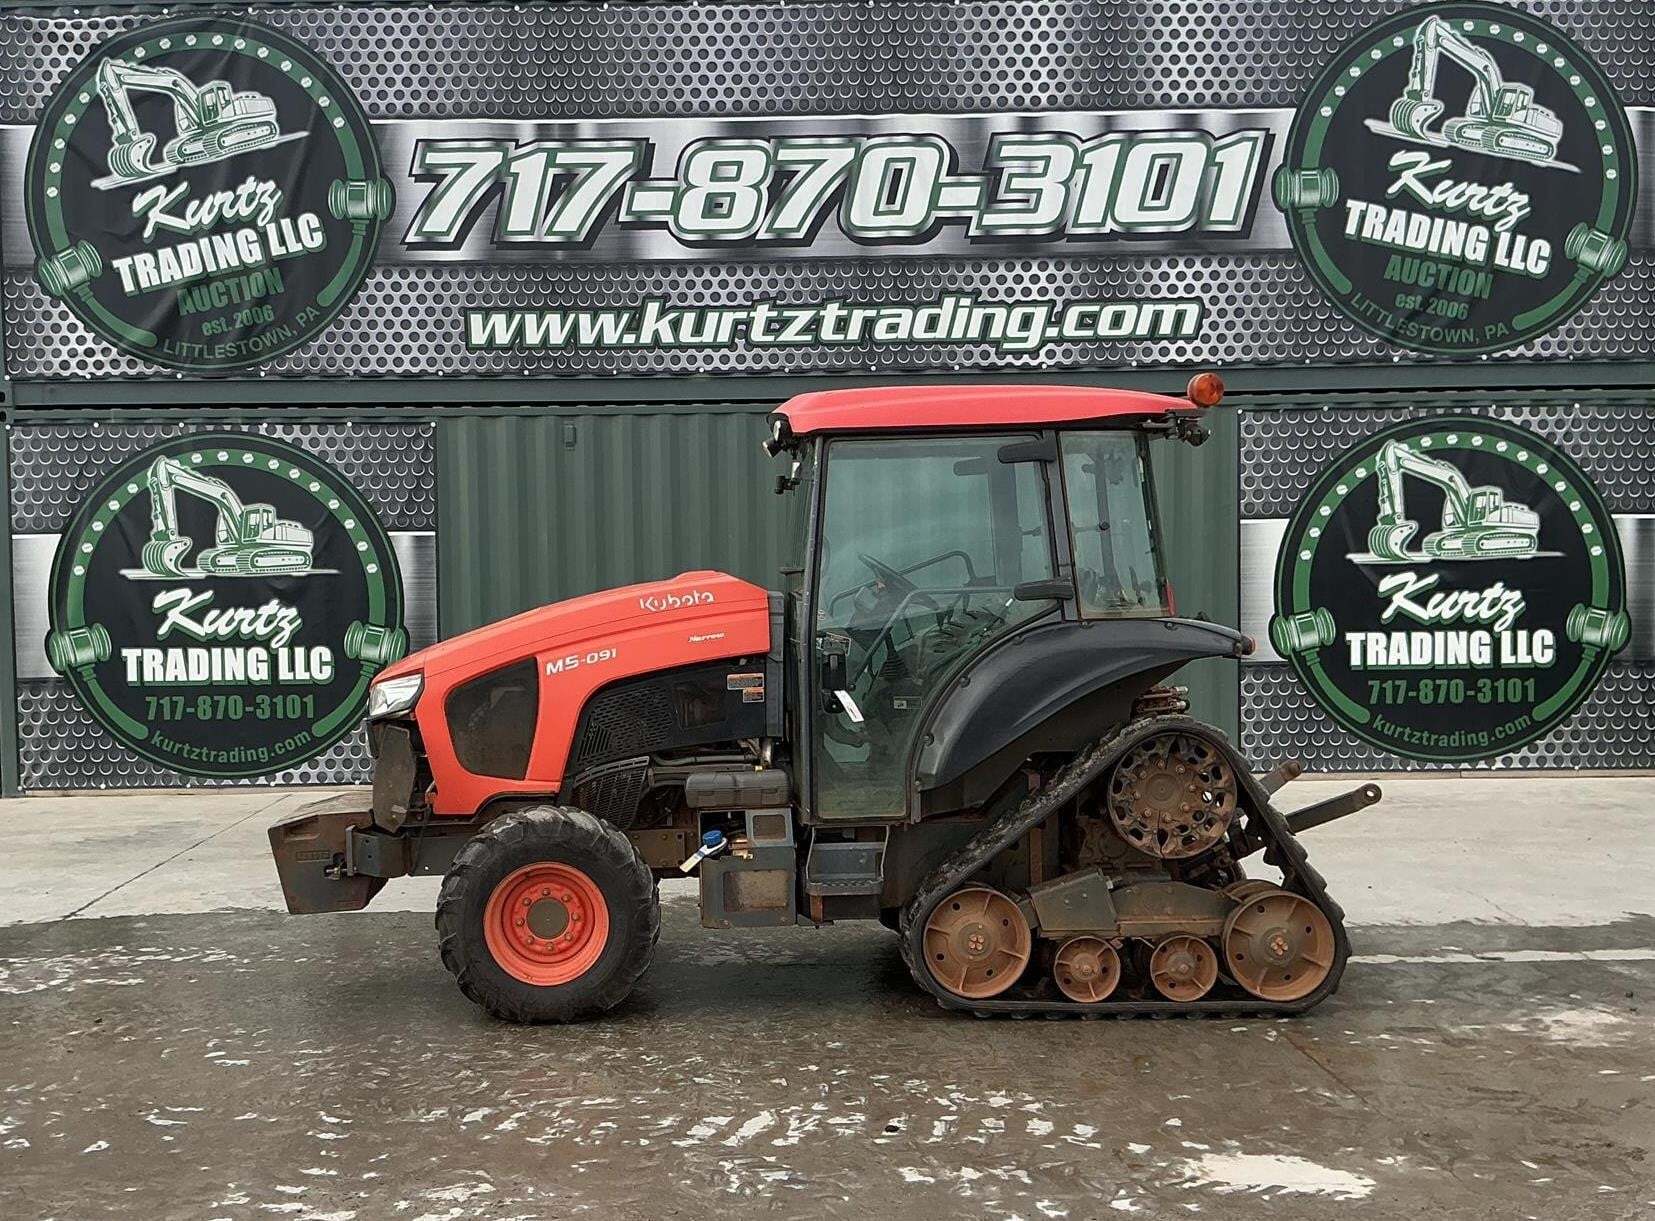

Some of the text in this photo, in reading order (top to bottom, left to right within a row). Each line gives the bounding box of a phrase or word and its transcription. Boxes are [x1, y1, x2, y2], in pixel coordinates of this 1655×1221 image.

[133, 176, 282, 240] Kurtz
[408, 133, 1270, 246] 717-870-3101
[1386, 150, 1531, 232] Kurtz
[113, 212, 325, 294] TRADING LLC
[1344, 199, 1552, 277] TRADING LLC
[177, 267, 285, 316] AUCTION
[1384, 255, 1494, 300] AUCTION
[201, 304, 275, 337] est. 2006
[465, 296, 1203, 355] www.kurtztrading.com
[1350, 293, 1510, 344] LITTLESTOWN, PA
[1426, 296, 1470, 320] 2006
[163, 306, 321, 360] LITTLESTOWN, PA
[152, 587, 302, 649] Kurtz
[639, 590, 715, 612] Kubota
[1378, 572, 1527, 631] Kurtz
[121, 646, 334, 684] TRADING LLC
[1346, 630, 1557, 668] TRADING LLC
[145, 695, 316, 721] 717-870-3101
[1368, 678, 1536, 705] 717-870-3101
[150, 729, 312, 764] kurtztrading.com
[1372, 714, 1533, 748] kurtztrading.com
